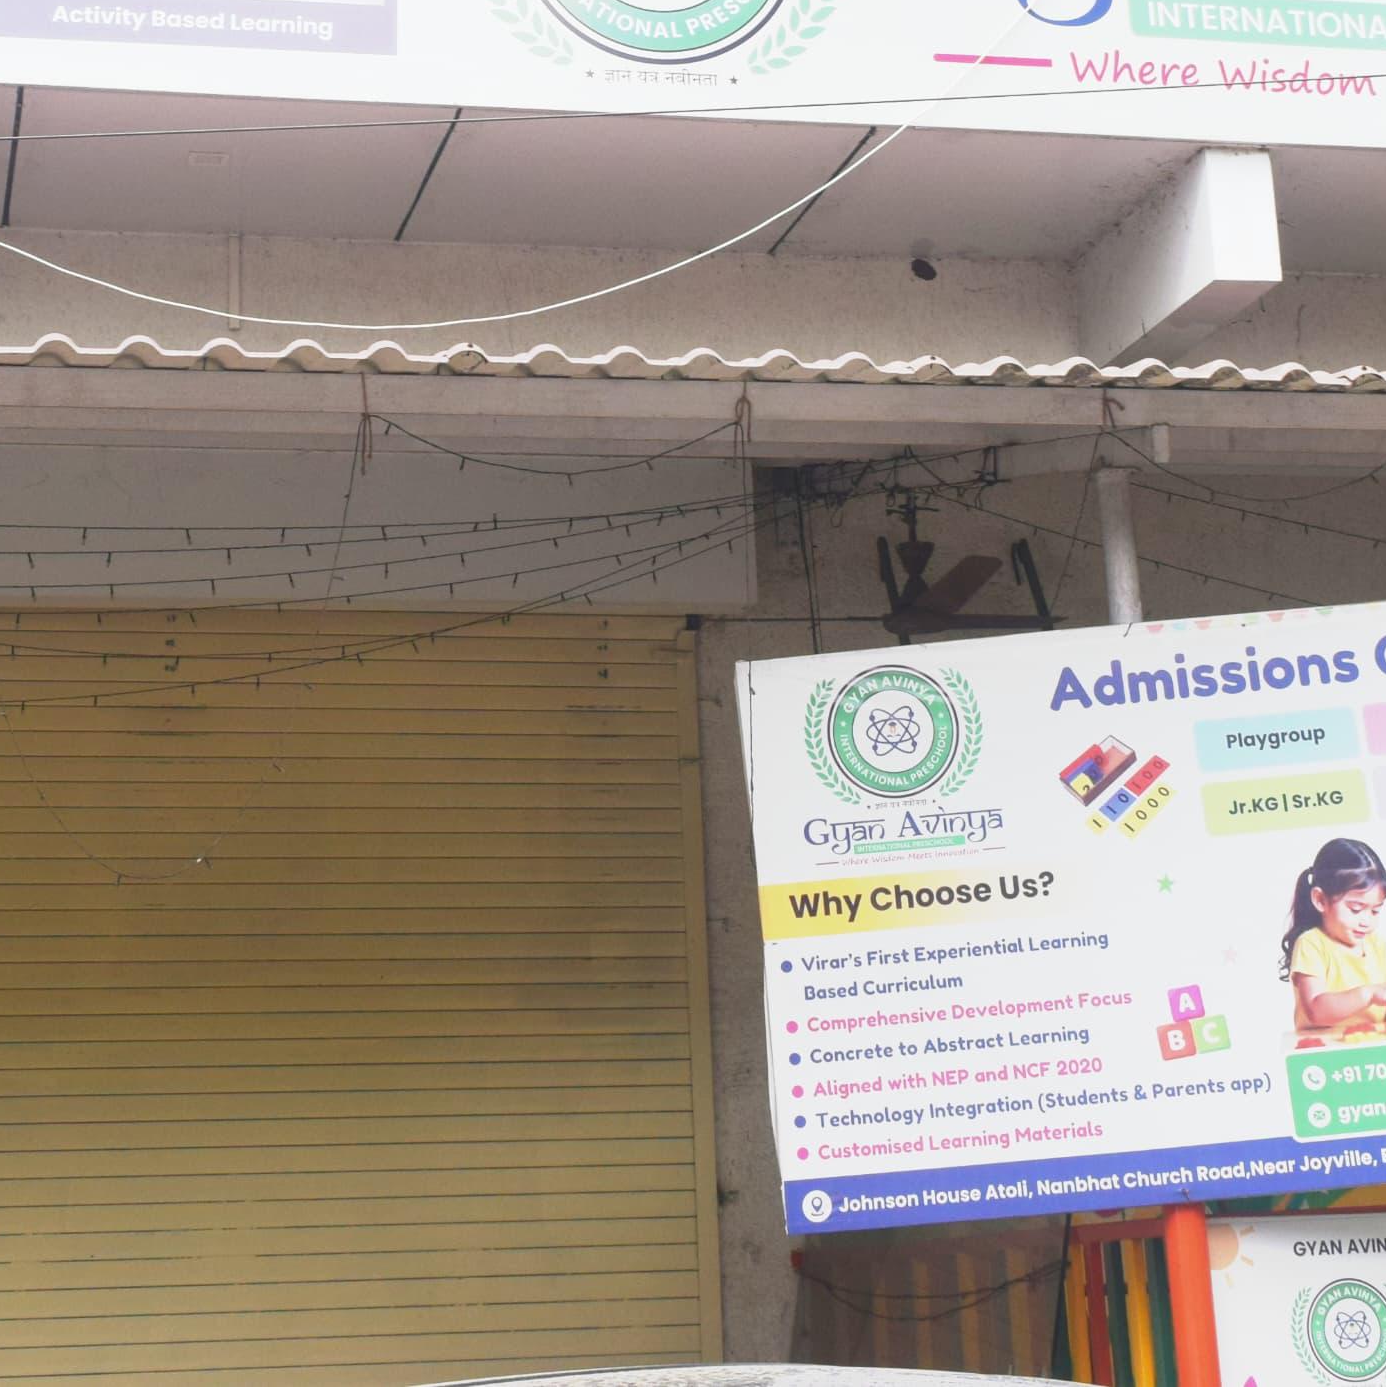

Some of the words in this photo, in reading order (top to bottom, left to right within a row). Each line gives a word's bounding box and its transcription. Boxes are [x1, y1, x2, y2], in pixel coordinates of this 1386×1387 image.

[52, 5, 145, 31] Activity
[151, 10, 224, 31] Based
[230, 13, 334, 40] Learning
[1070, 50, 1200, 90] Where
[1218, 58, 1376, 99] Wisdom
[844, 679, 878, 714] GYAN
[882, 675, 936, 706] AVINYA
[1050, 645, 1359, 712] Admissions
[840, 734, 909, 787] INTERNATIONAL
[911, 725, 948, 782] PRESCHOOL
[1226, 725, 1326, 750] Playgroup
[803, 818, 885, 855] Gyan
[897, 806, 1004, 842] Avinya
[789, 893, 862, 923] Why
[869, 882, 992, 912] Choose
[999, 871, 1054, 900] Us?
[867, 948, 909, 967] First
[914, 938, 1024, 964] Experiential
[1029, 931, 1109, 953] Learning
[804, 982, 858, 1000] Based
[863, 974, 963, 996] Curriculum
[1178, 993, 1197, 1013] A
[807, 1007, 947, 1033] Comprehensive
[951, 994, 1074, 1021] Development
[1078, 990, 1133, 1007] Focus
[809, 1043, 893, 1064] Concrete
[898, 1041, 918, 1056] to
[923, 1032, 1004, 1054] Abstract
[1009, 1026, 1090, 1048] Learning
[1166, 1030, 1186, 1052] B
[1202, 1022, 1221, 1043] C
[813, 1077, 883, 1100] Aligned
[888, 1074, 927, 1091] with
[931, 1070, 969, 1087] NEP
[975, 1067, 1009, 1083] and
[1013, 1063, 1051, 1079] NCF
[1057, 1058, 1103, 1076] 2020
[1331, 1067, 1363, 1085] +91
[816, 1104, 925, 1129] Technology
[929, 1096, 1033, 1120] Integration
[1037, 1087, 1128, 1113] (Students
[1134, 1085, 1147, 1100] &
[1152, 1078, 1225, 1100] Parents
[1231, 1072, 1272, 1094] app)
[818, 1139, 925, 1161] Customised
[929, 1130, 1010, 1151] Learning
[1015, 1121, 1103, 1144] Materials
[838, 1190, 919, 1214] Johnson
[922, 1186, 981, 1206] House
[985, 1180, 1033, 1201] Atoli,
[1037, 1173, 1121, 1198] Nanbhat
[1123, 1167, 1194, 1189] Church
[1300, 1147, 1378, 1173] Joyville,
[1293, 1240, 1343, 1257] GYAN
